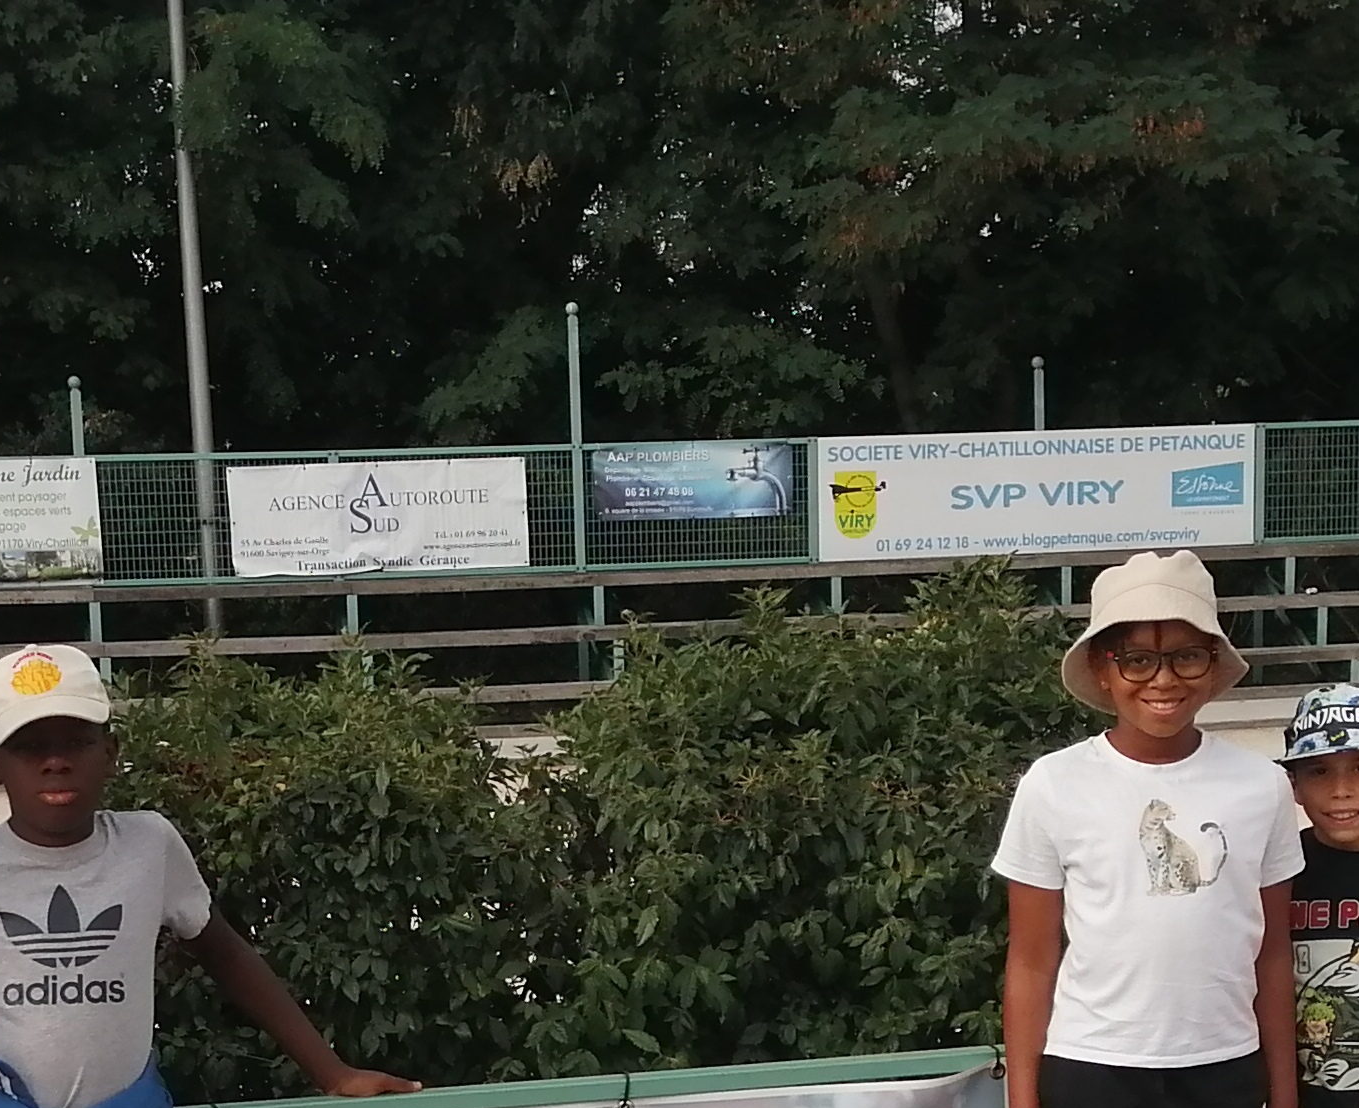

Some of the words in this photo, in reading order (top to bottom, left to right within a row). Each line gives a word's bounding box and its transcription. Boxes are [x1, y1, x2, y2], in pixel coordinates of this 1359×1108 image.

[607, 452, 633, 462] AAP
[637, 450, 710, 462] PLOMBIERS
[828, 445, 903, 462] SOCIETE
[909, 437, 1114, 459] VIRY-CHATILLONNAISE
[1121, 437, 1144, 453] DE
[1150, 433, 1245, 452] PETANQUE
[21, 464, 82, 487] Jardin
[18, 492, 66, 504] paysager
[639, 487, 650, 497] 21
[653, 487, 666, 496] 47
[951, 483, 1027, 510] SVP
[1039, 479, 1124, 507] VIRY
[3, 507, 46, 518] espaces
[49, 506, 72, 516] verts
[268, 494, 346, 511] AGENCE
[876, 539, 890, 552] 01
[895, 538, 912, 551] 69
[916, 537, 933, 551] 24
[938, 536, 951, 550] 12
[956, 536, 969, 548] 18
[983, 527, 1200, 549] www.blogpetanque.com/svcpviry
[296, 558, 366, 572] Transaction
[373, 556, 413, 568] Syndic
[420, 554, 470, 567] Gérance
[1290, 900, 1330, 930] NE
[3, 974, 125, 1006] adidas
